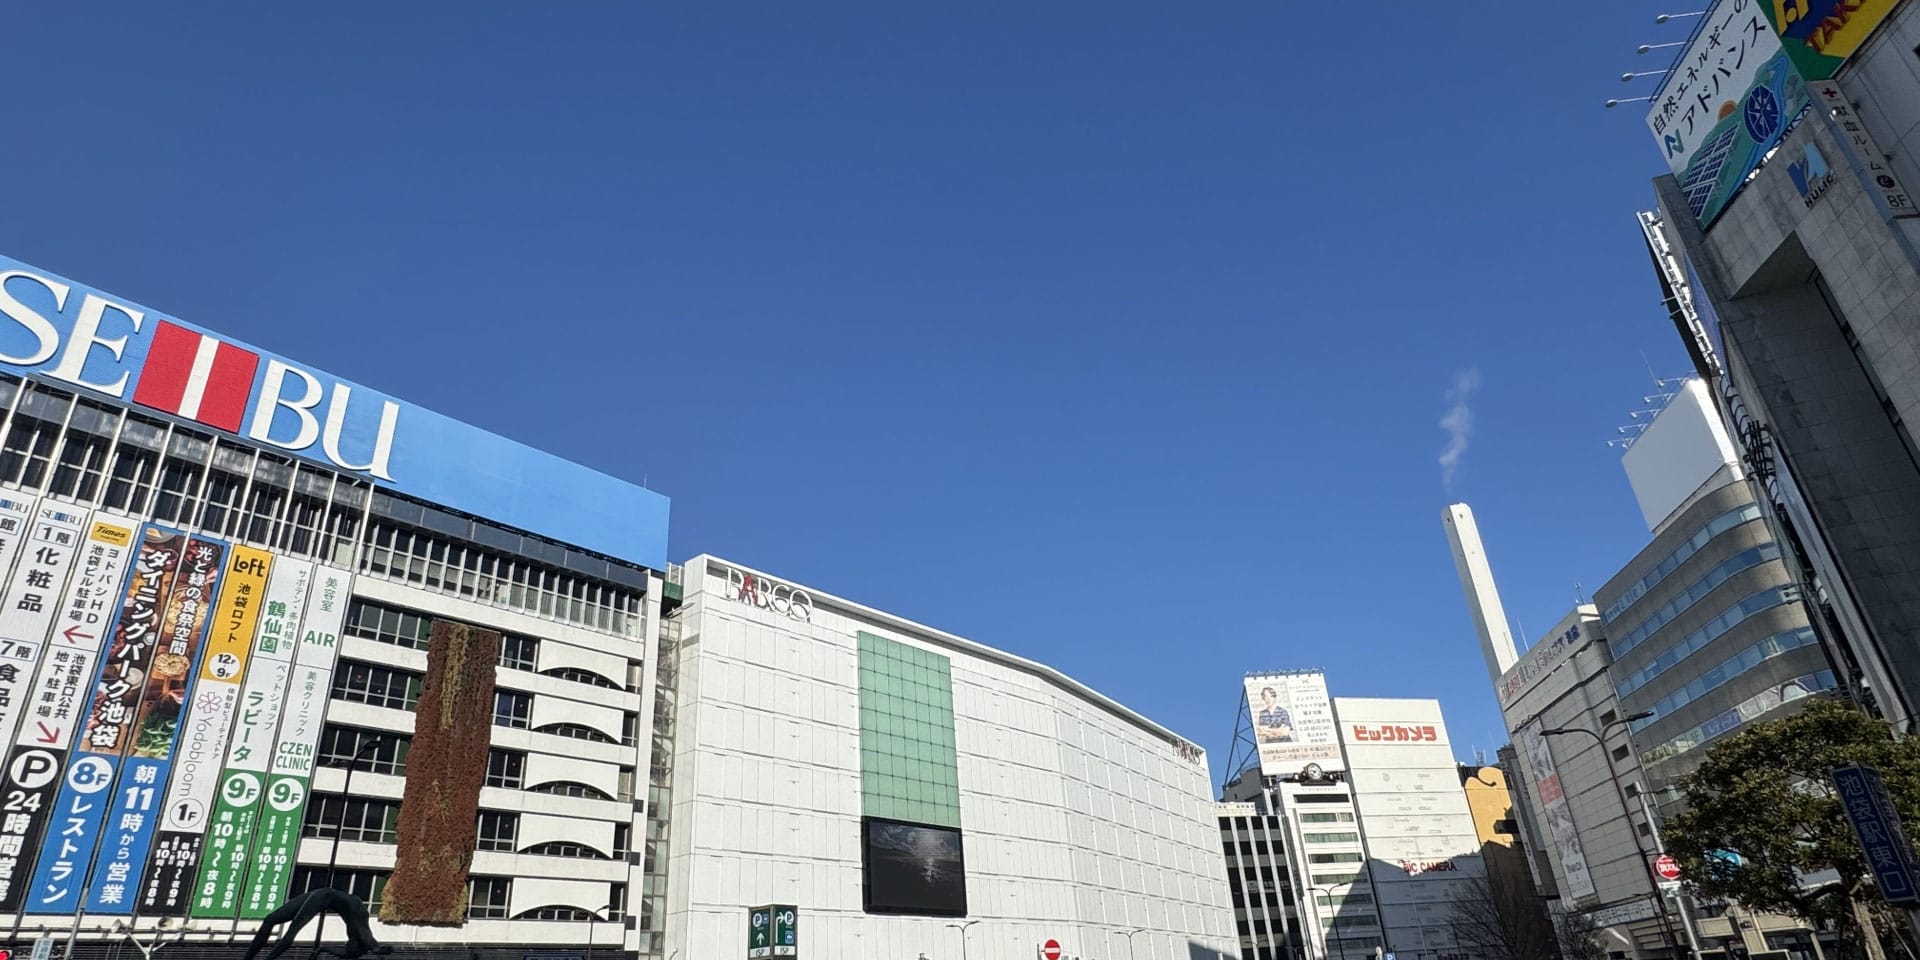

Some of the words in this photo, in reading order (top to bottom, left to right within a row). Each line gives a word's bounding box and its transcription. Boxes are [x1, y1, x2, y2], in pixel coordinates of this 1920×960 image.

[1681, 16, 1767, 136] アドバンス
[1804, 174, 1835, 208] HULIC
[1887, 194, 1908, 207] 8F
[0, 270, 400, 483] SEIBU
[43, 527, 71, 544] 1階
[95, 526, 126, 538] Times
[17, 546, 60, 612] 化粧品
[69, 544, 104, 621] 池袋ビル駐車場
[86, 549, 119, 624] ヨドバシHD
[320, 577, 338, 612] 美容室
[725, 566, 813, 620] PARCO
[228, 583, 251, 643] 池袋ロフト
[259, 600, 287, 654] 鶴仙園
[304, 630, 336, 648] AIR
[0, 640, 32, 658] 7階
[90, 550, 171, 748] ダイニングパーク池袋
[36, 650, 69, 717] 地下駐車場
[54, 652, 86, 719] 池袋東口公共
[264, 664, 286, 730] ペットショップ
[295, 671, 317, 736] 美容クリニック
[234, 691, 264, 762] ラビータ
[279, 742, 313, 757] CZEN
[1353, 725, 1437, 741] ビックカメラ
[19, 755, 51, 783] P
[74, 763, 109, 785] 8F
[179, 716, 214, 797] Yodobloom
[275, 756, 310, 771] CLINIC
[179, 804, 197, 821] 1F
[227, 778, 257, 799] 9F
[272, 783, 300, 804] 9F
[43, 796, 93, 904] レストラン
[100, 764, 158, 904] 朝11時から営業
[1839, 774, 1907, 893] 池袋駅東口
[1420, 860, 1457, 872] CAMERA
